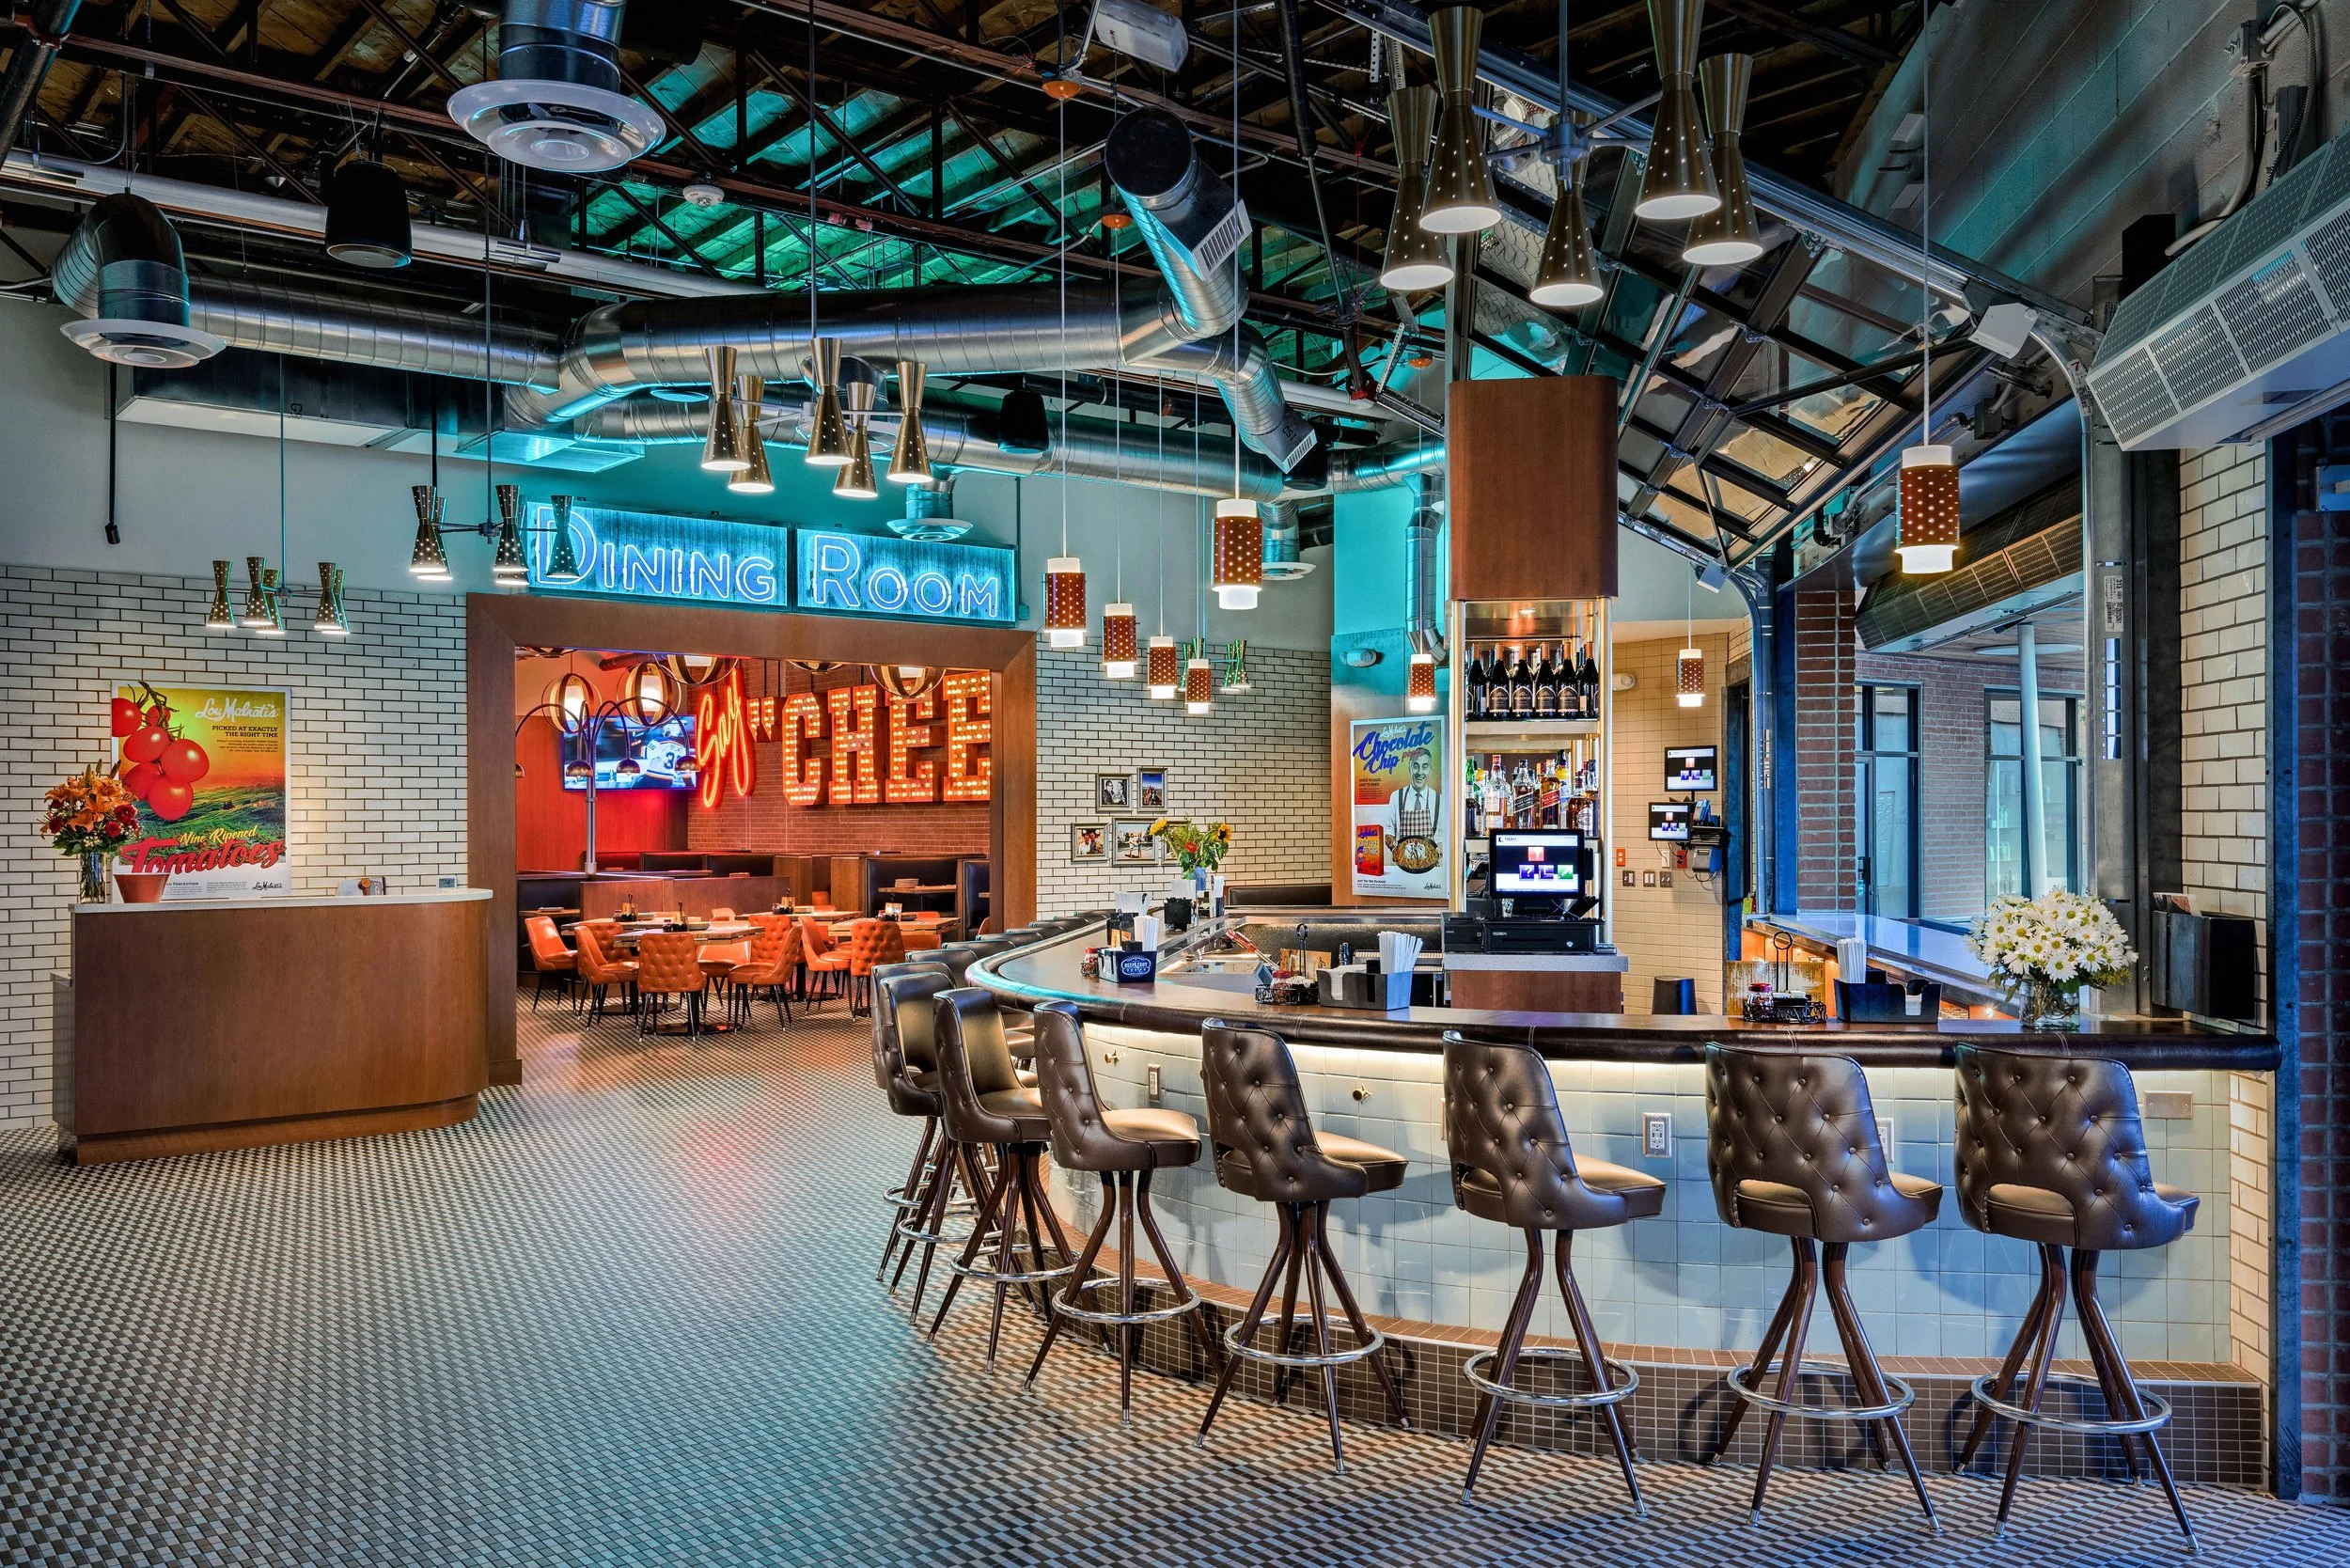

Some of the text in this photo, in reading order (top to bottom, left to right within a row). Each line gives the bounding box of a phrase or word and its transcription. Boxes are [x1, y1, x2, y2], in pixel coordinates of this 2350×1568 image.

[534, 505, 998, 618] DINING ROOM
[697, 666, 753, 809] Say
[1353, 721, 1435, 760] Chocolate
[1363, 751, 1400, 775] Chip
[209, 824, 258, 845] Ripened
[120, 836, 287, 875] Tomatoes
